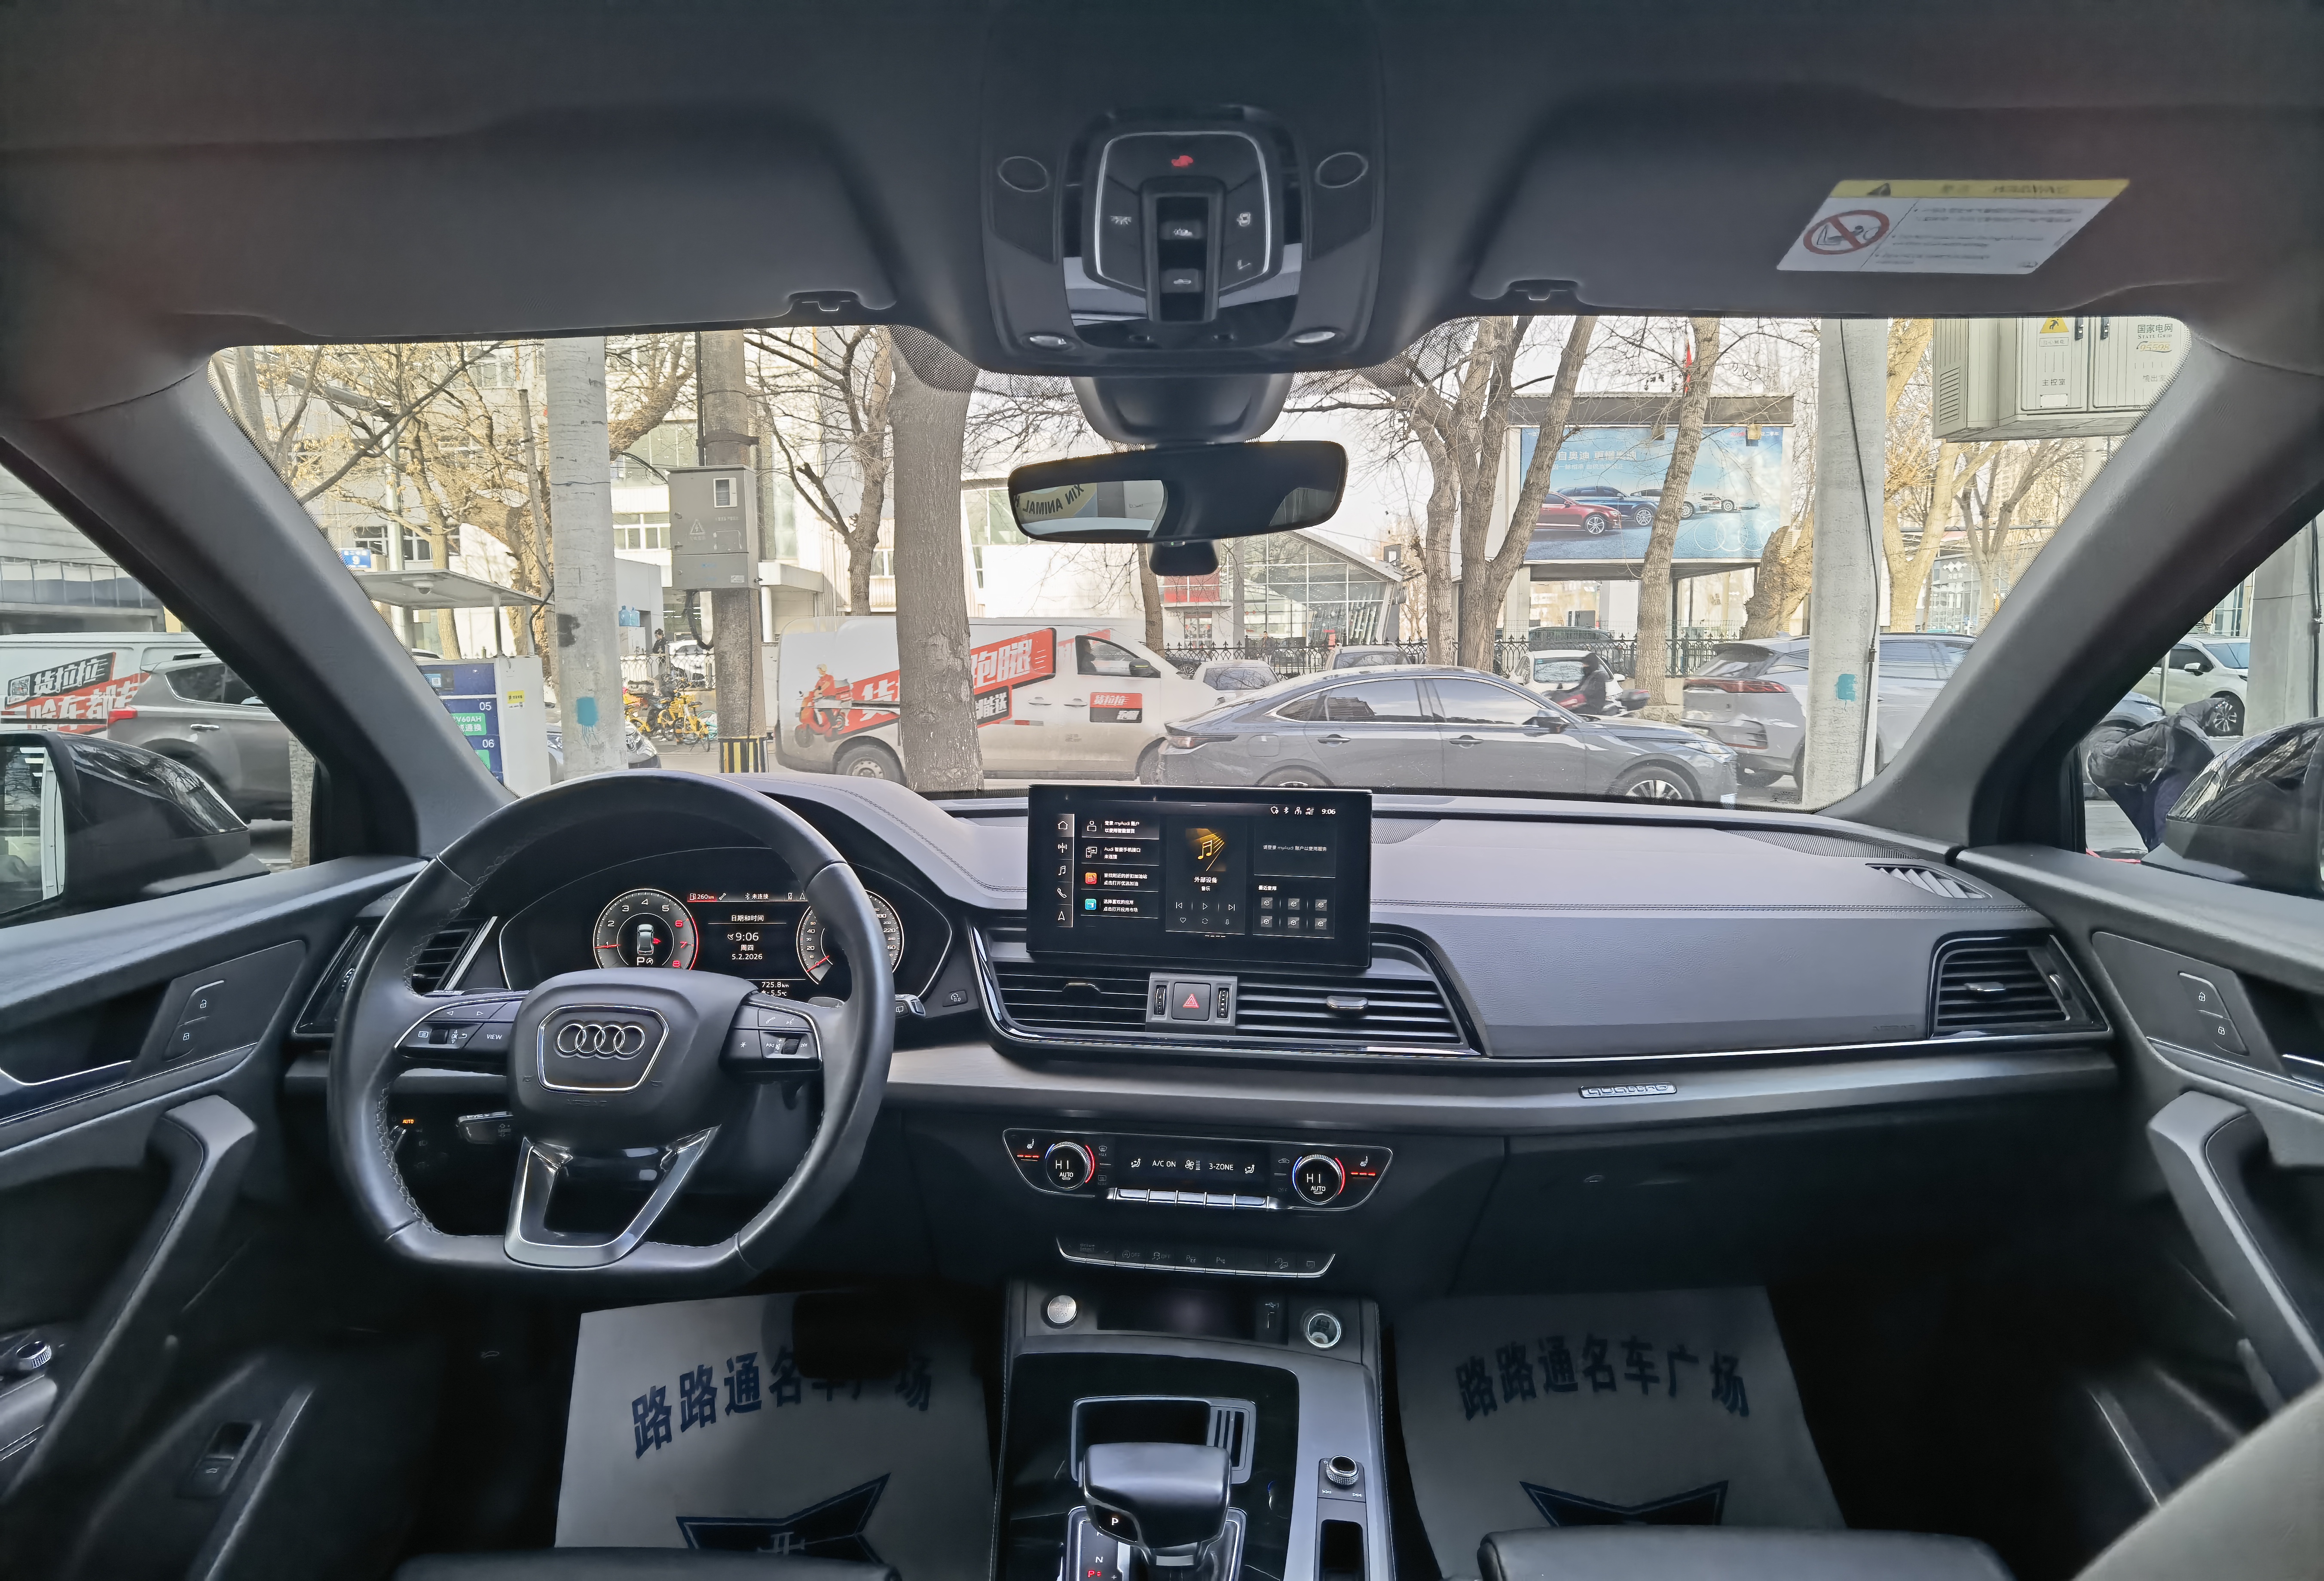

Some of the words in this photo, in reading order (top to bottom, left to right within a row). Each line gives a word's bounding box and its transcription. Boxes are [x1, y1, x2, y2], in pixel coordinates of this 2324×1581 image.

[2137, 324, 2173, 333] 国家电网
[1556, 451, 1590, 461] 自奥迪
[34, 658, 100, 693] 货拉拉
[1093, 695, 1128, 706] 货拉拉
[479, 702, 492, 711] 05
[482, 739, 495, 748] 06
[735, 932, 759, 941] 9:06
[637, 957, 645, 966] P
[1588, 1085, 1668, 1096] quattro
[1456, 1333, 1749, 1421] 路路通名车广场
[632, 1346, 932, 1459] 路路通名场
[1111, 1517, 1119, 1526] P
